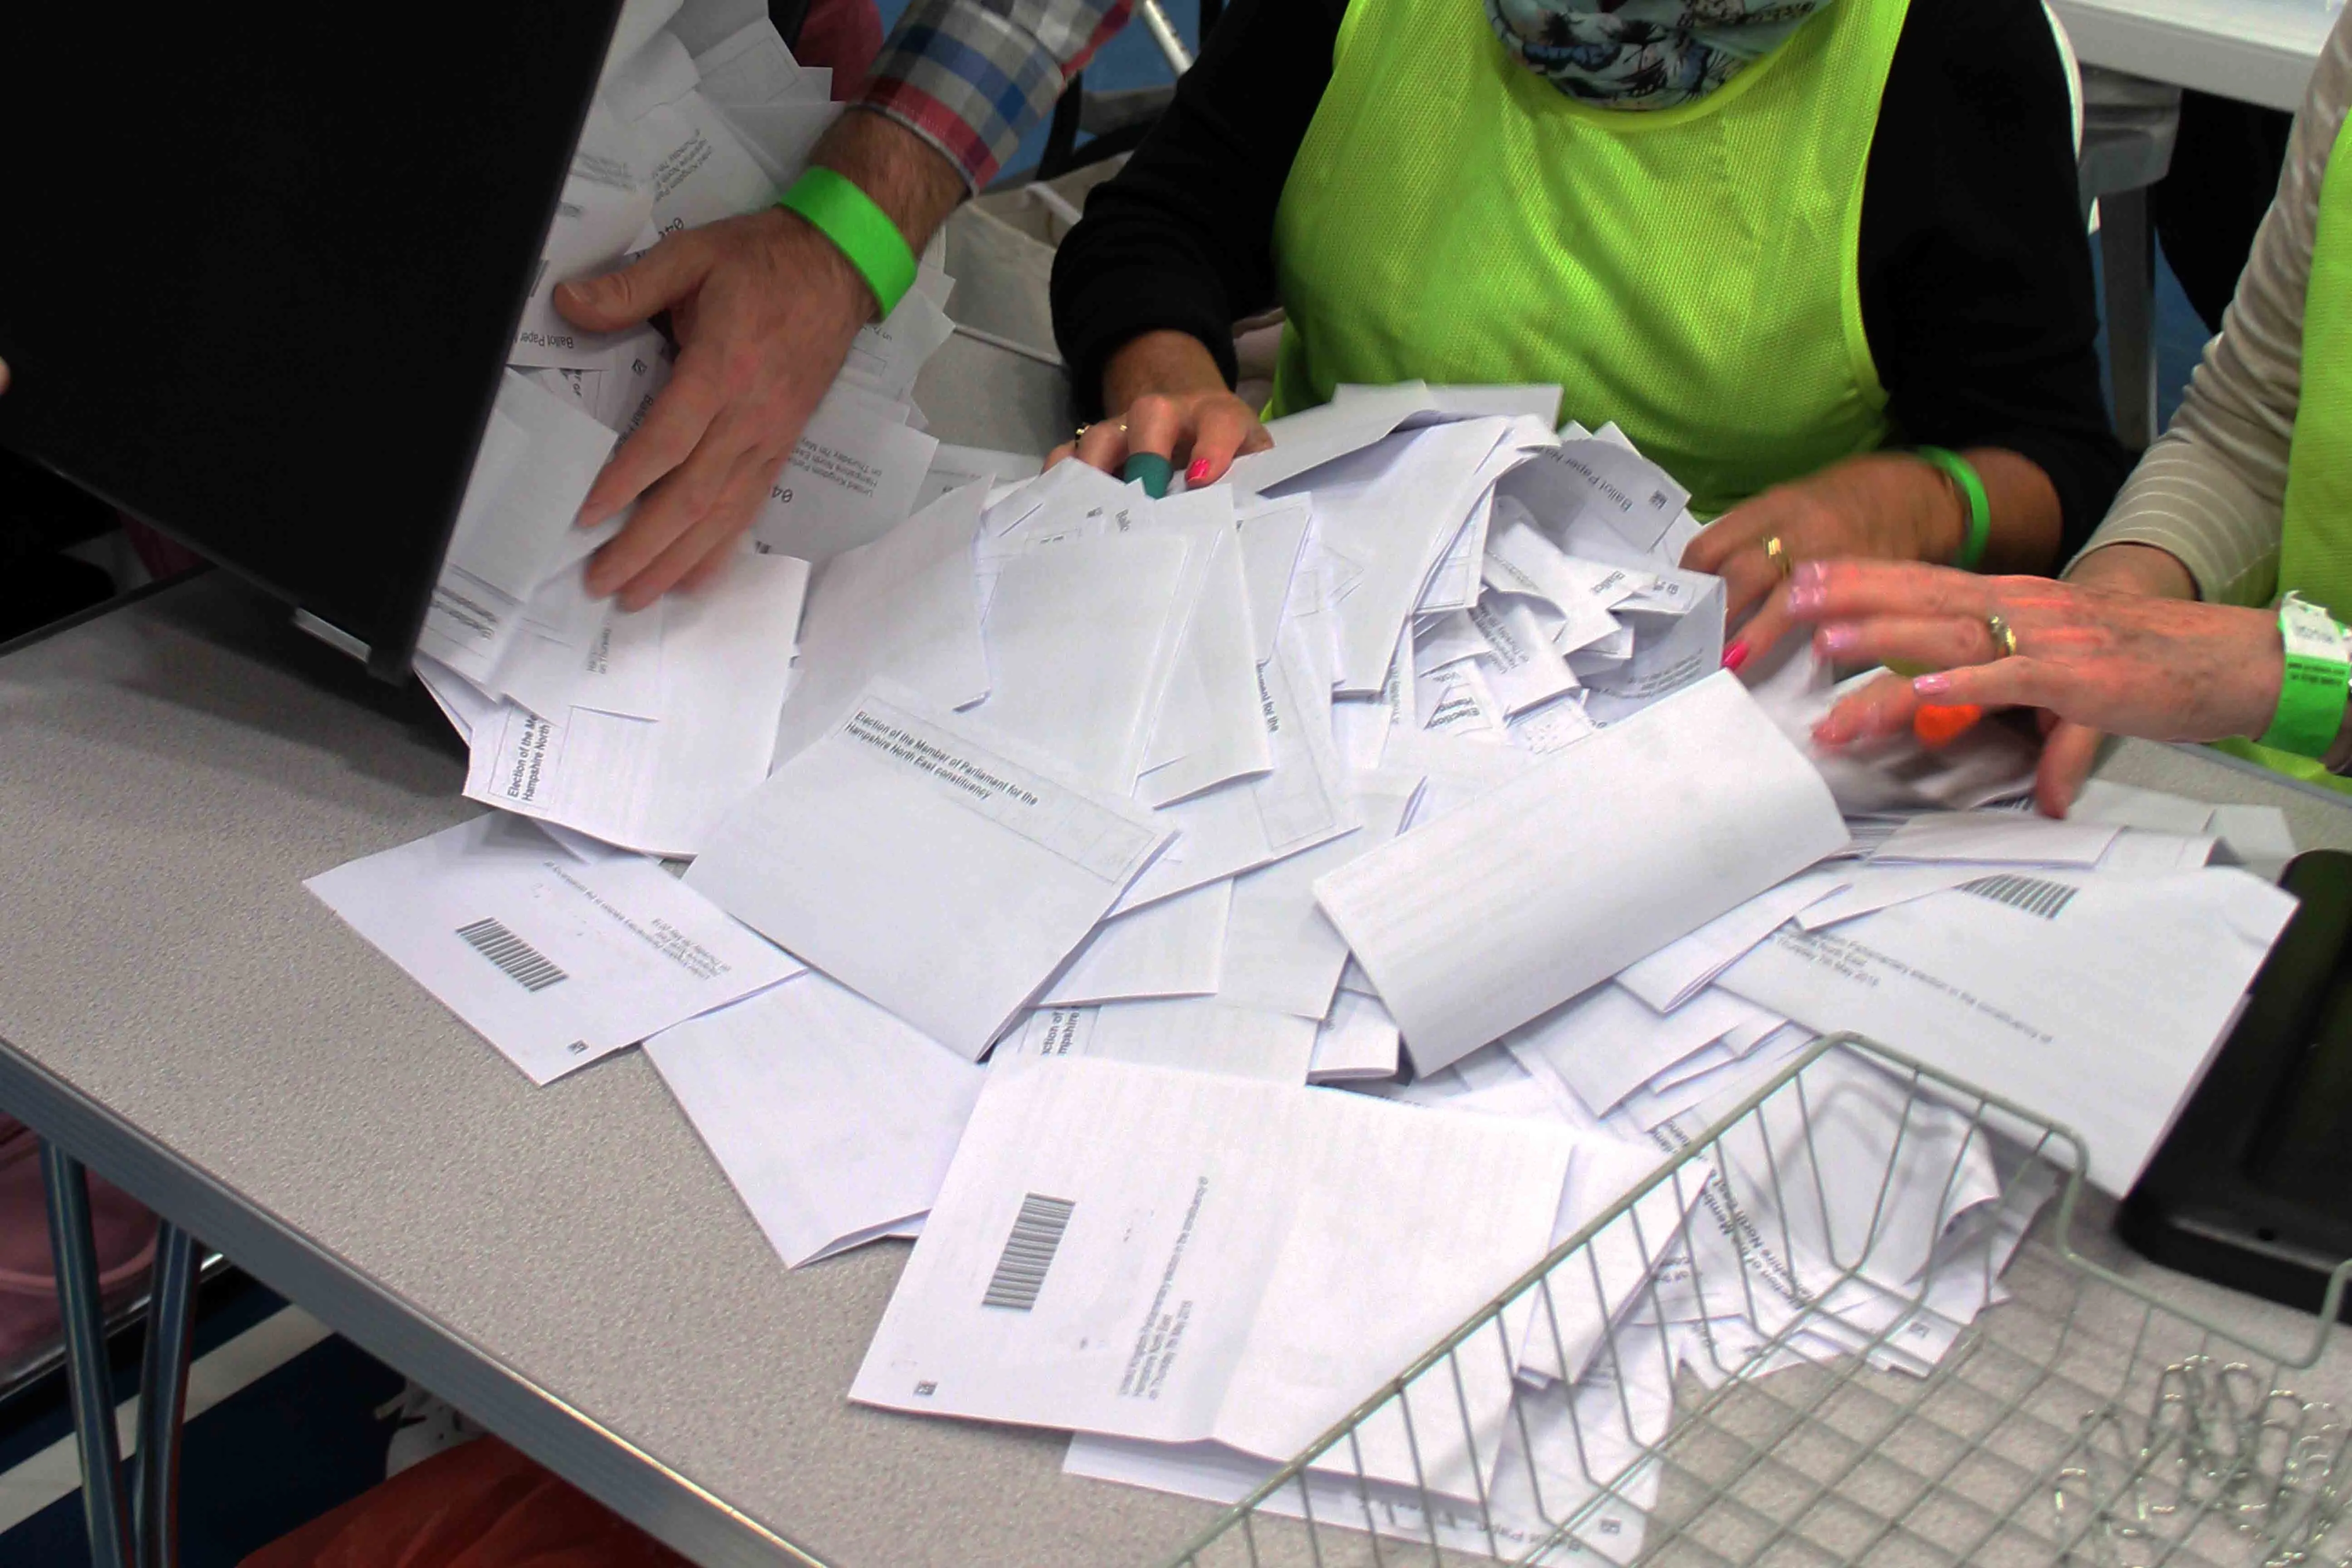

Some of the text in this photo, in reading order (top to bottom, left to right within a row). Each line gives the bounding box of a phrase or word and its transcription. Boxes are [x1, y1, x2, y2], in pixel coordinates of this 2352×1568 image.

[520, 330, 574, 348] Ballot Paper
[1565, 456, 1600, 486] Paper
[1598, 480, 1633, 514] Ballot
[517, 746, 530, 758] of
[520, 730, 534, 747] the
[521, 724, 551, 802] Hampshire North
[844, 720, 993, 802] Hampshire North East constituency
[854, 710, 1039, 807] Election of the Member of Parliament for the
[507, 758, 527, 798] Election
[1050, 1010, 1064, 1024] of
